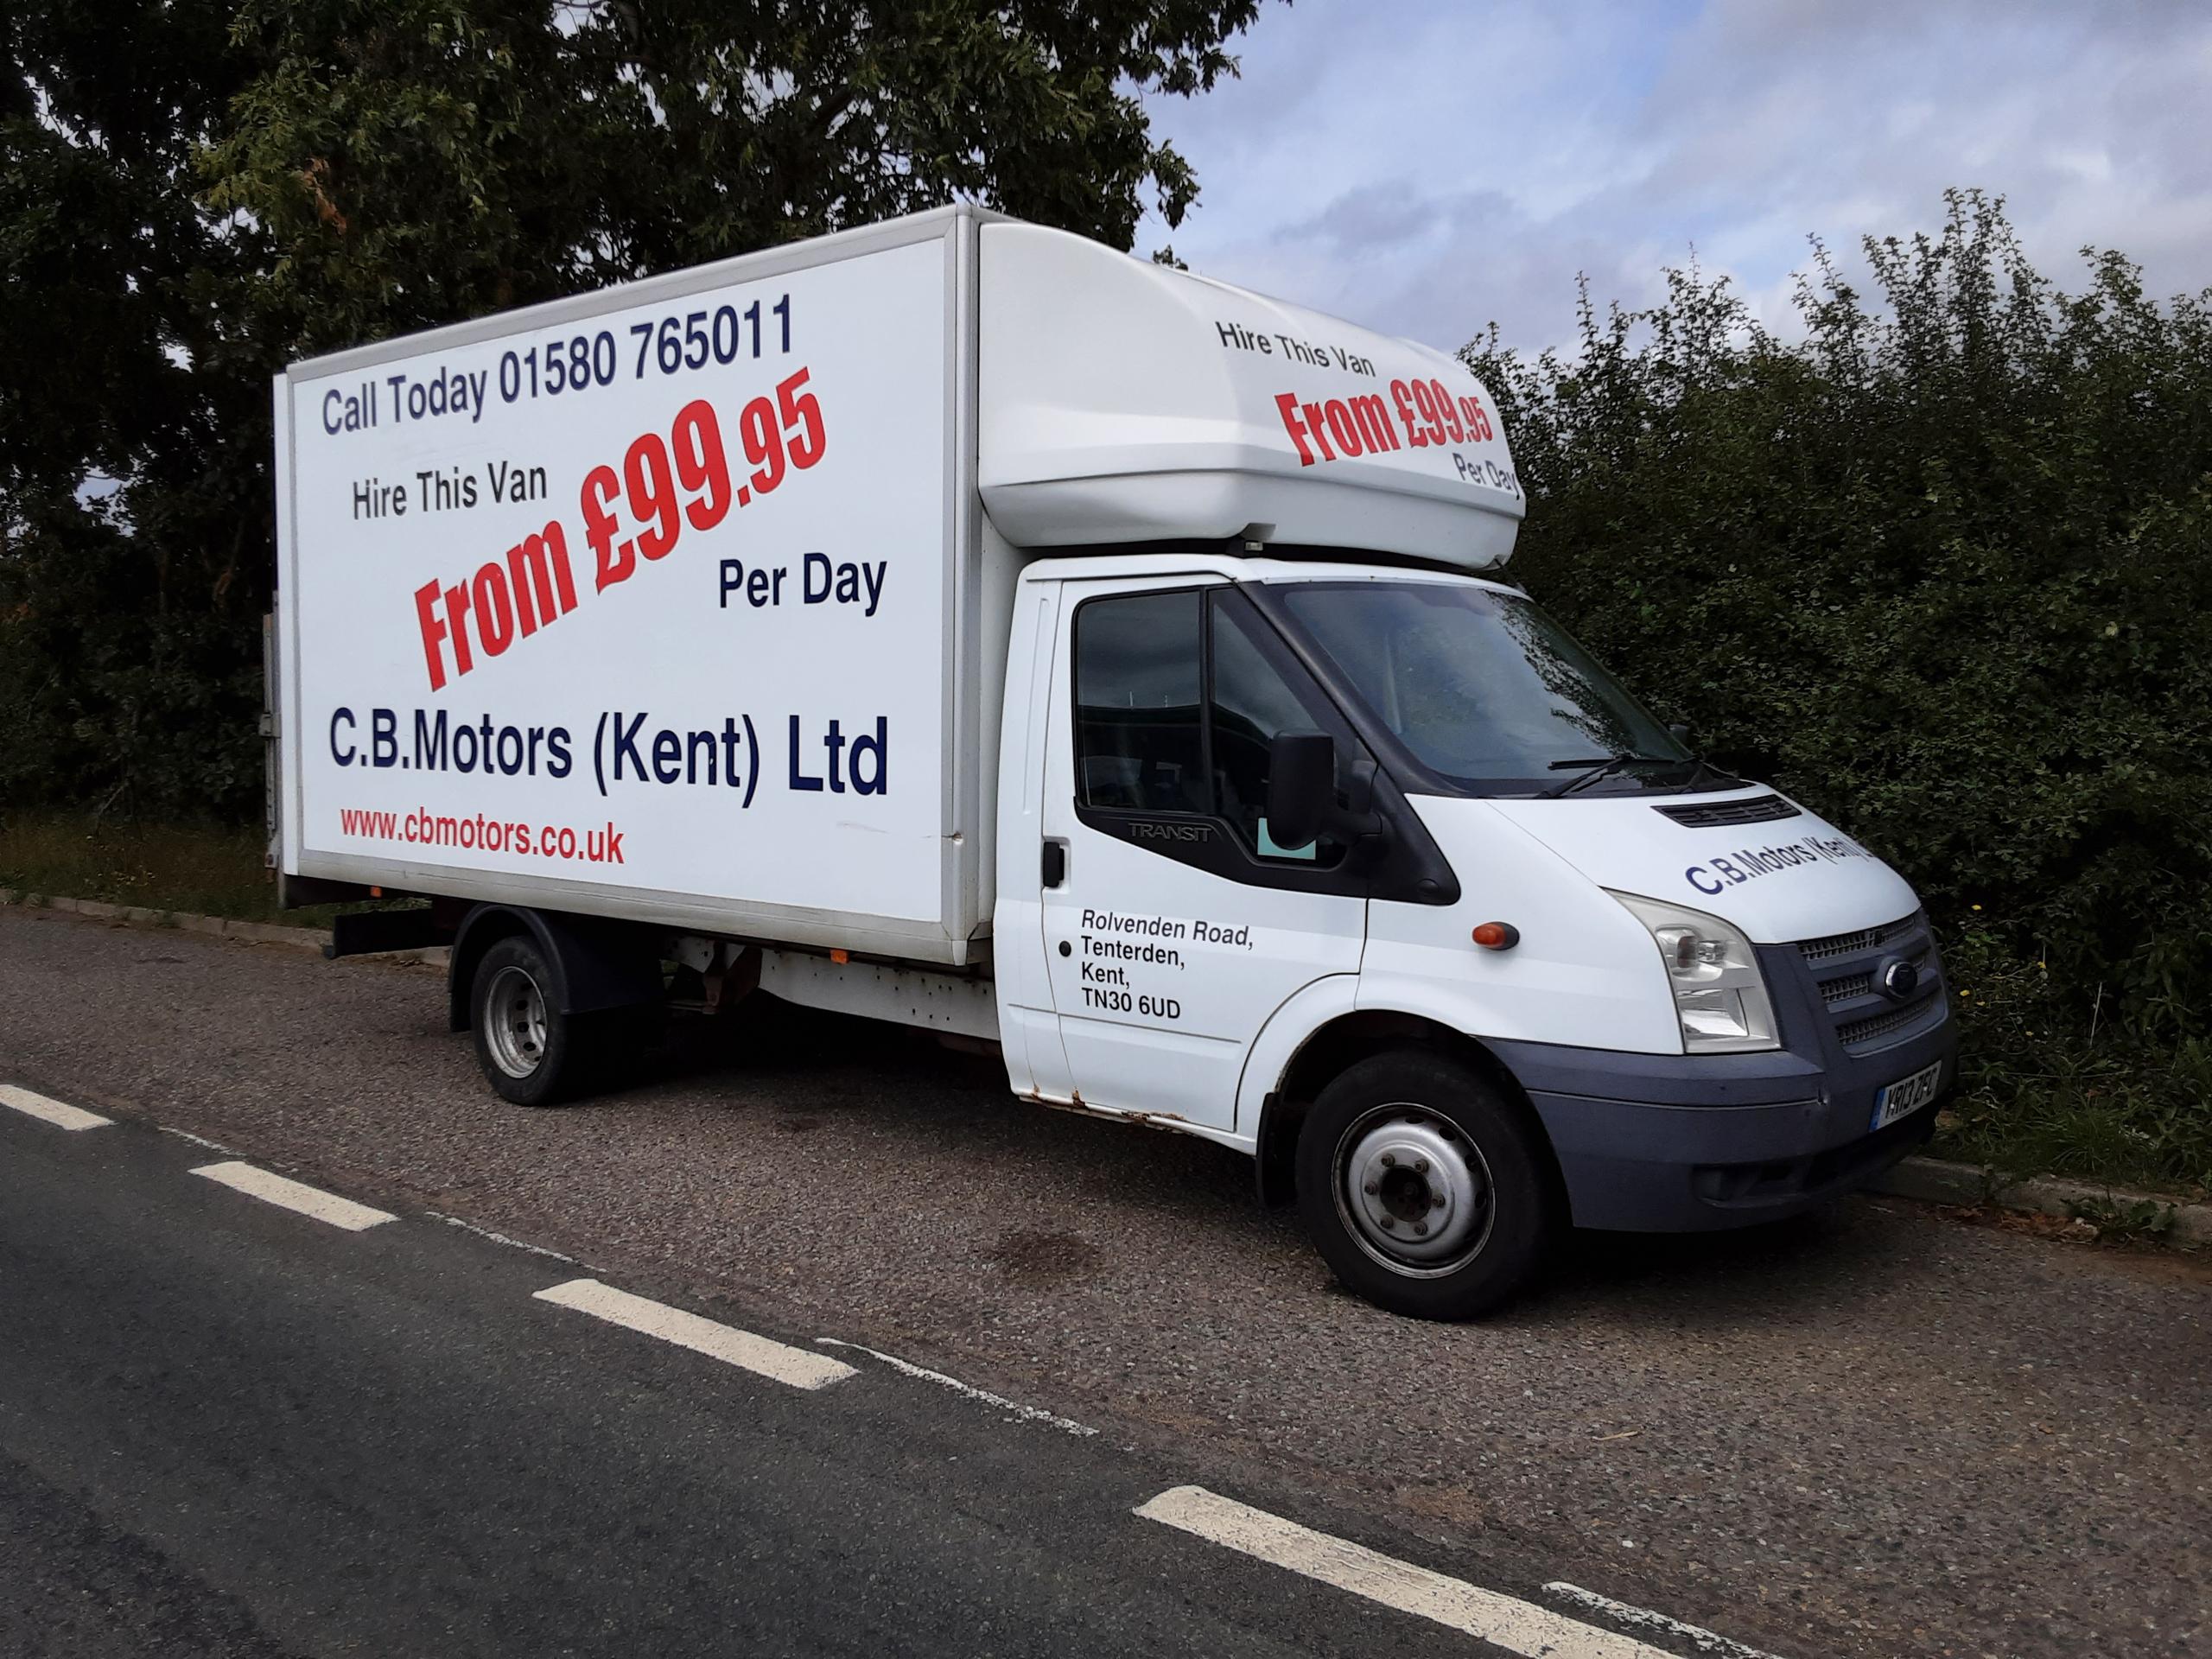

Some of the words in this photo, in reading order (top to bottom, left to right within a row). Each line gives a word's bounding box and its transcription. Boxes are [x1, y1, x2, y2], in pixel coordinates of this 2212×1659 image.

[322, 382, 377, 435] Call
[387, 368, 487, 423] Today
[499, 331, 616, 403] 01580
[630, 294, 792, 378] 765011
[1215, 321, 1273, 355] Hire
[1274, 334, 1330, 368] This
[1331, 346, 1376, 377] Van
[1274, 392, 1402, 467] From
[1389, 378, 1493, 449] £99.95
[353, 480, 407, 520] Hire
[416, 466, 478, 512] This
[486, 461, 547, 505] Van
[1452, 453, 1486, 485] Per
[1485, 460, 1520, 501] Day
[413, 520, 579, 693] From
[580, 365, 828, 595] £99.95
[720, 558, 786, 608] Per
[803, 552, 887, 617] Day
[328, 707, 573, 779] C.B.Motors
[593, 712, 760, 809] (Kent)
[788, 715, 888, 796] Ltd
[340, 805, 625, 864] www.cbmotors.co.uk
[1128, 823, 1211, 842] TRANSIT
[1685, 844, 1818, 895] C.B.Motors
[1081, 909, 1185, 939] Rolvenden
[1192, 920, 1254, 950] Road,
[1081, 936, 1185, 970] Tenterden,
[1081, 962, 1130, 989] Kent,
[1081, 987, 1132, 1012] TN30
[1138, 995, 1180, 1019] 6UD
